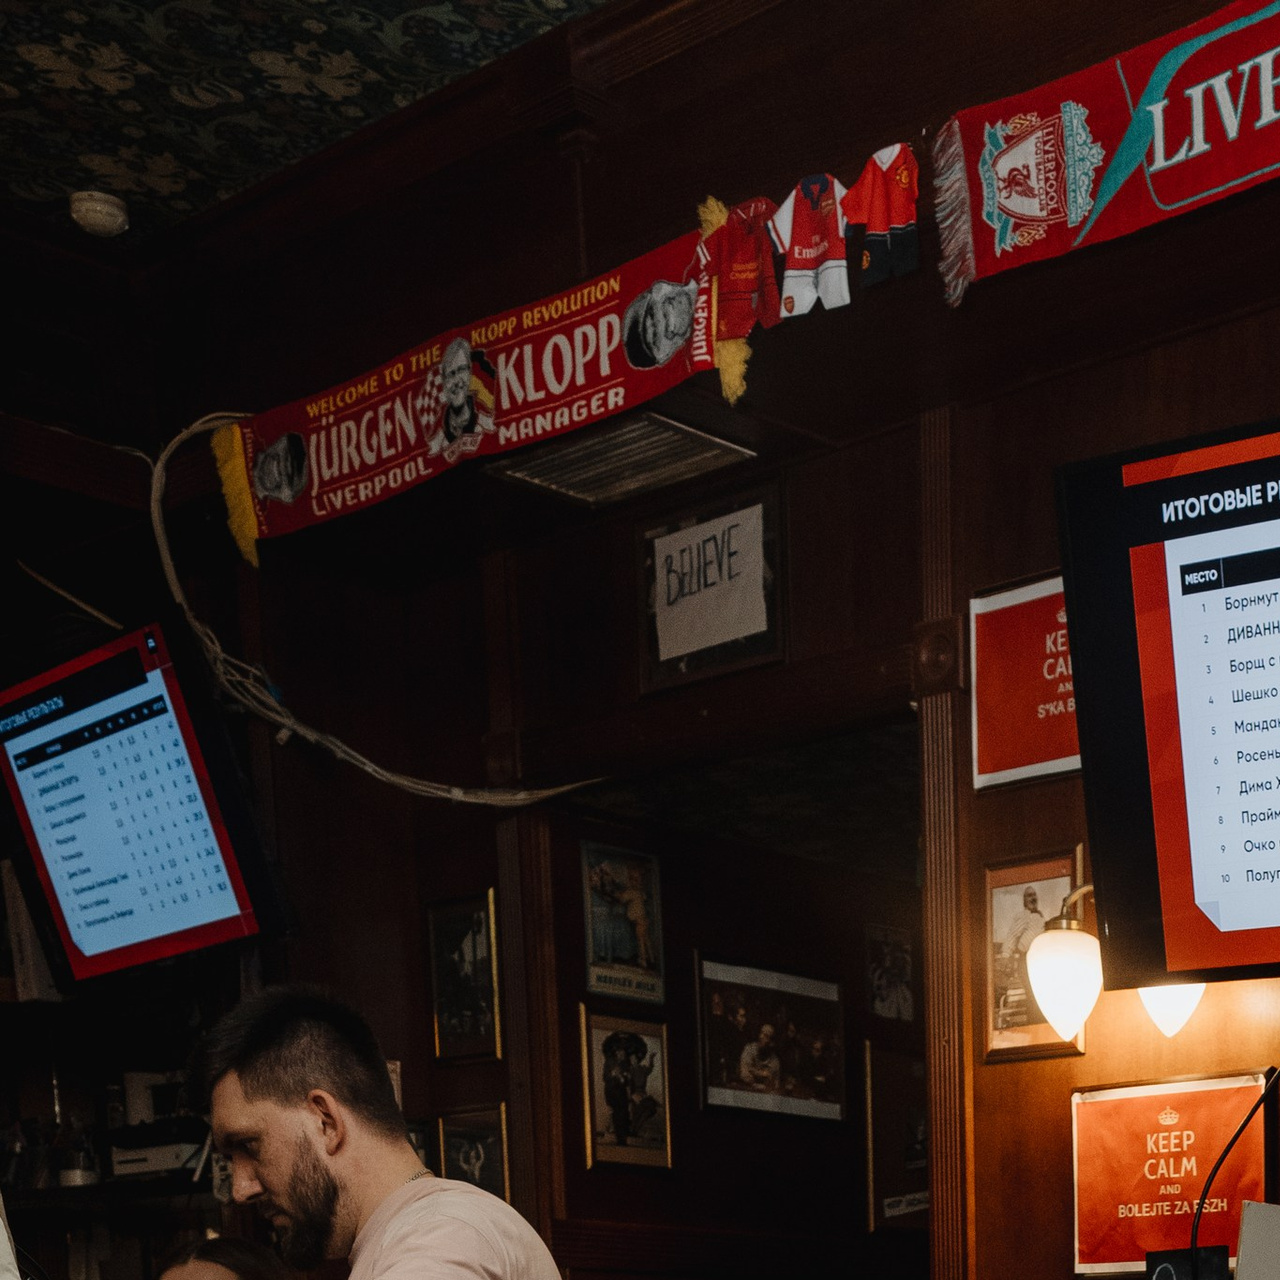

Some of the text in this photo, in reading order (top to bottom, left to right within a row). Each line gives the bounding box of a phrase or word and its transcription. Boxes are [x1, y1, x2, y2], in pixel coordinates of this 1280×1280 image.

[1042, 127, 1057, 213] LIVERPOOL
[306, 275, 621, 419] WELCOME TO THE KLOPP REVOLUTION
[309, 388, 418, 497] JÜRGEN
[497, 312, 621, 411] KLOPP
[312, 456, 433, 516] LIVERPOOL
[498, 386, 625, 446] MANAGER
[1162, 483, 1263, 524] ИТОГОВЫЕ
[665, 523, 742, 607] BELIEVE
[1184, 569, 1219, 586] МЕСТО
[1201, 603, 1206, 613] 1
[1224, 591, 1279, 612] Борнмут
[1046, 629, 1067, 654] KE
[1203, 634, 1209, 644] 2
[1043, 654, 1072, 680] CAL
[1206, 664, 1212, 675] 3
[1229, 658, 1266, 675] Борщ
[1268, 656, 1276, 667] с
[1057, 681, 1074, 693] AN
[1208, 696, 1214, 705] 4
[1231, 687, 1279, 704] Шешко
[1211, 726, 1217, 736] 5
[1213, 757, 1219, 766] 6
[1215, 785, 1221, 795] 7
[1239, 780, 1273, 797] Дима
[1218, 815, 1224, 825] 8
[1220, 844, 1226, 853] 9
[1243, 839, 1276, 853] Очко
[1221, 873, 1231, 883] 10
[1146, 1130, 1196, 1154] KEEP
[1144, 1156, 1198, 1180] CALM
[1159, 1184, 1182, 1195] AND
[1118, 1201, 1172, 1218] BOLEJTE
[1174, 1200, 1191, 1215] ZA
